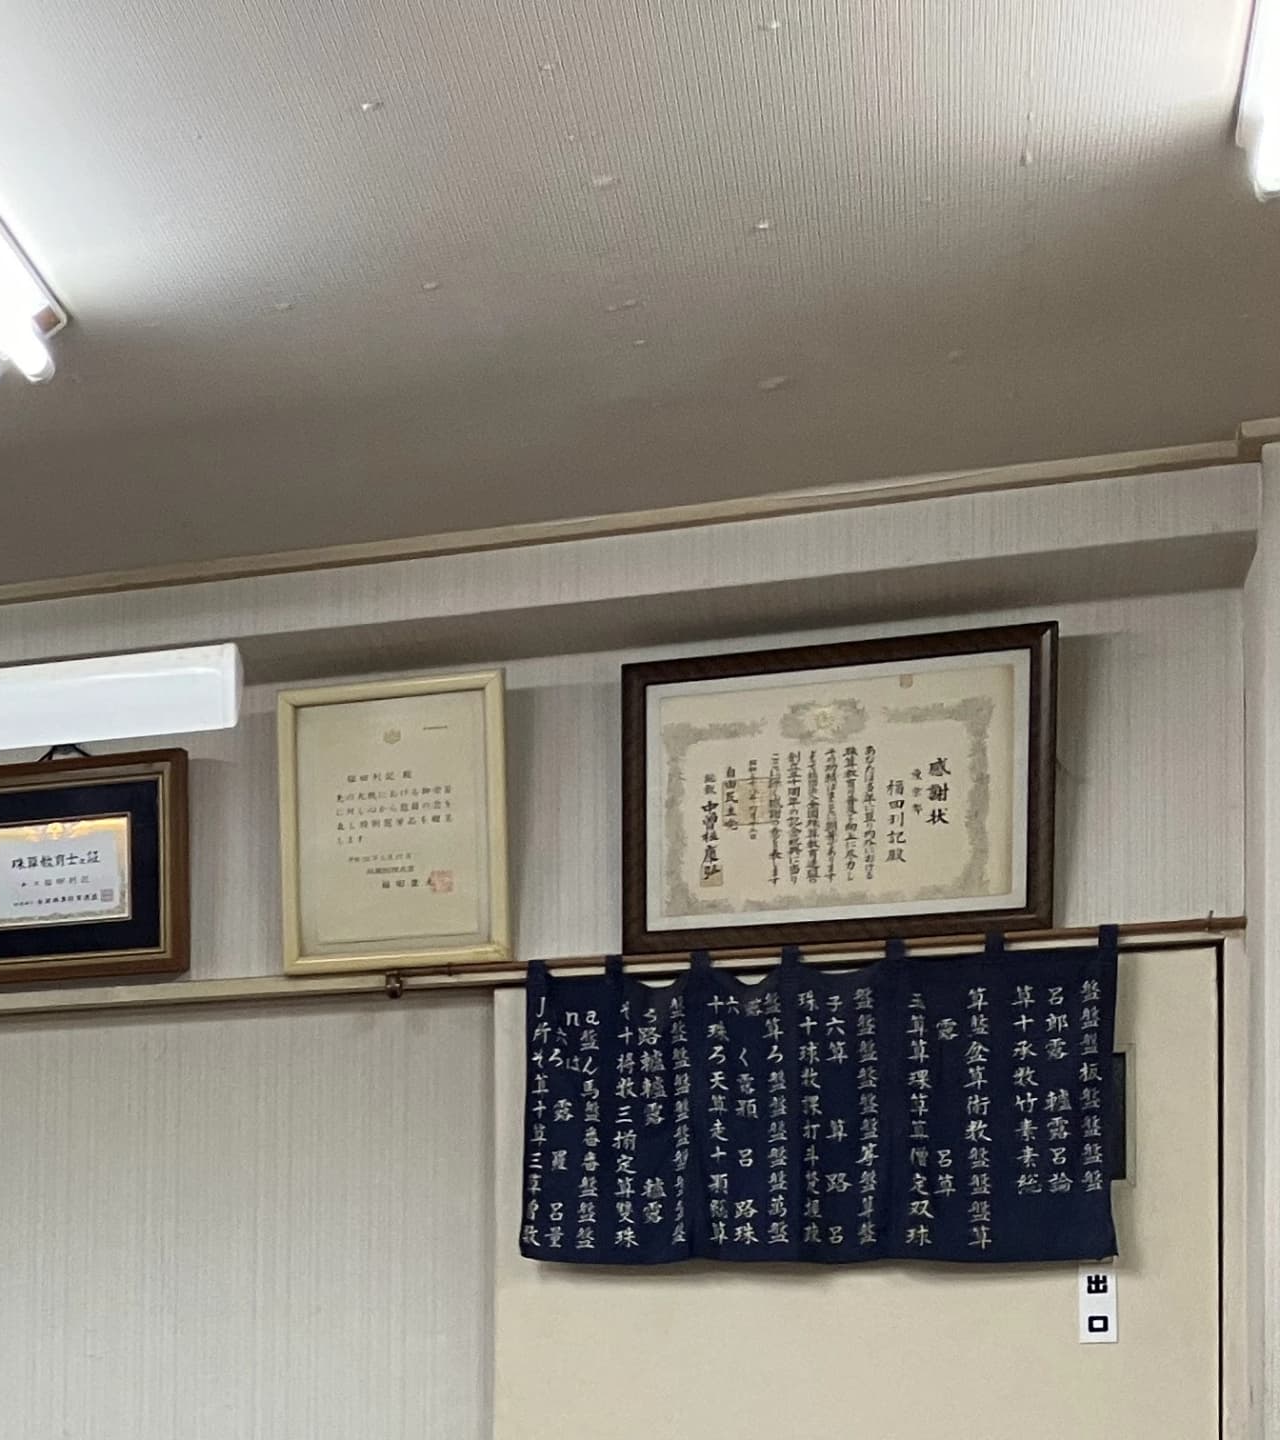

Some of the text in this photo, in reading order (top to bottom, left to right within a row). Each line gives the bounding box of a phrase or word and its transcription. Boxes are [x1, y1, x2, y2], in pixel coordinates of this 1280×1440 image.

[926, 757, 951, 825] 感謝状
[1087, 1274, 1108, 1333] 出口
